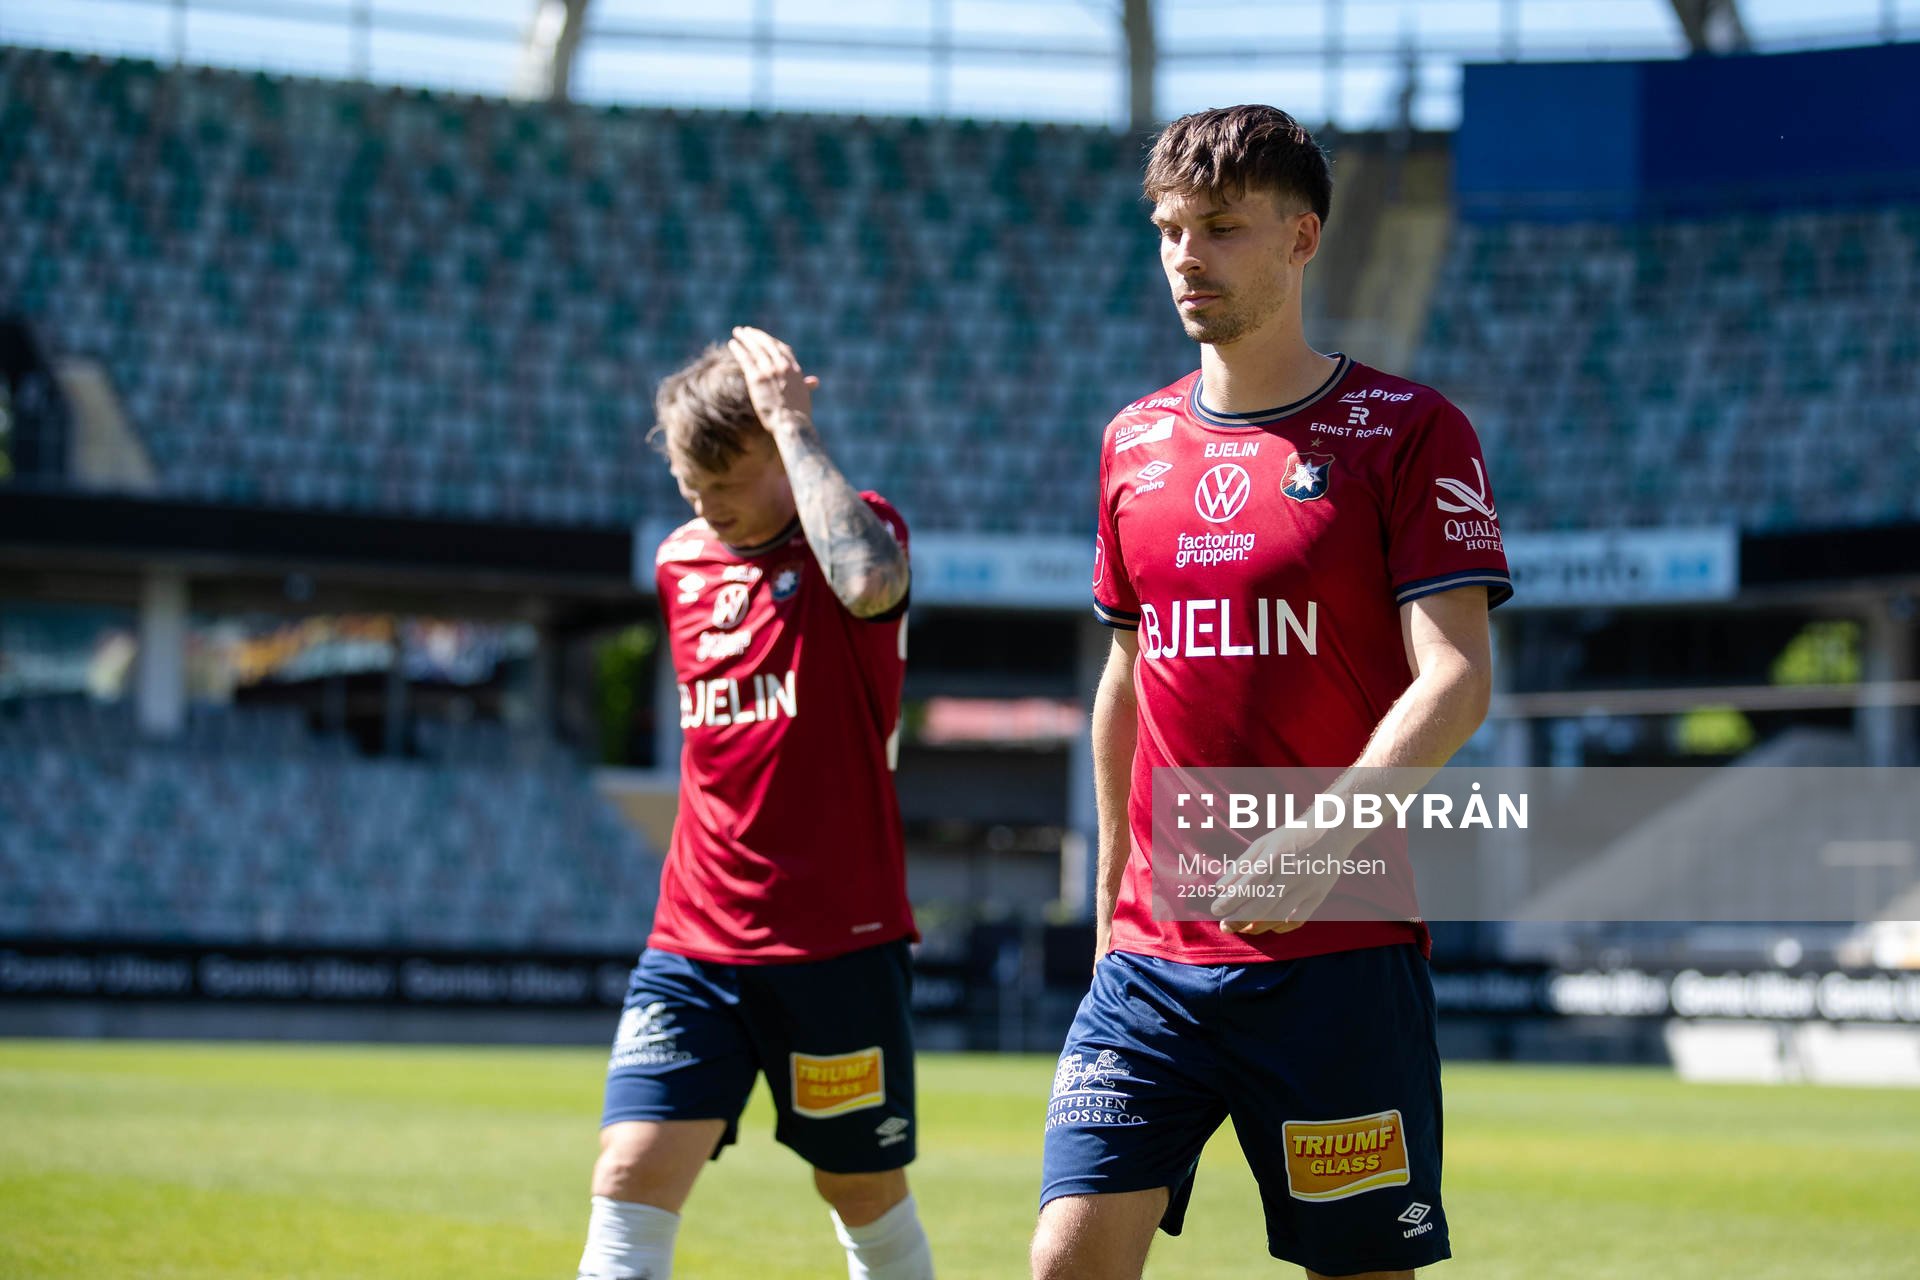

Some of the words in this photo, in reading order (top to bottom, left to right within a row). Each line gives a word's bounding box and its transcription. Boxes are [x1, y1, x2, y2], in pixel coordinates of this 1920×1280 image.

[1144, 396, 1183, 409] BYGG
[1369, 388, 1414, 402] BYGG
[1310, 422, 1352, 437] ERNST
[1204, 442, 1260, 458] BJELIN
[1135, 479, 1165, 495] umbro
[1177, 530, 1255, 550] factoring
[1175, 547, 1249, 568] gruppen.
[1140, 598, 1317, 659] BJELIN
[1293, 1125, 1395, 1157] TRIUMF
[1310, 1154, 1381, 1176] GLASS
[1403, 1221, 1433, 1238] umbro
